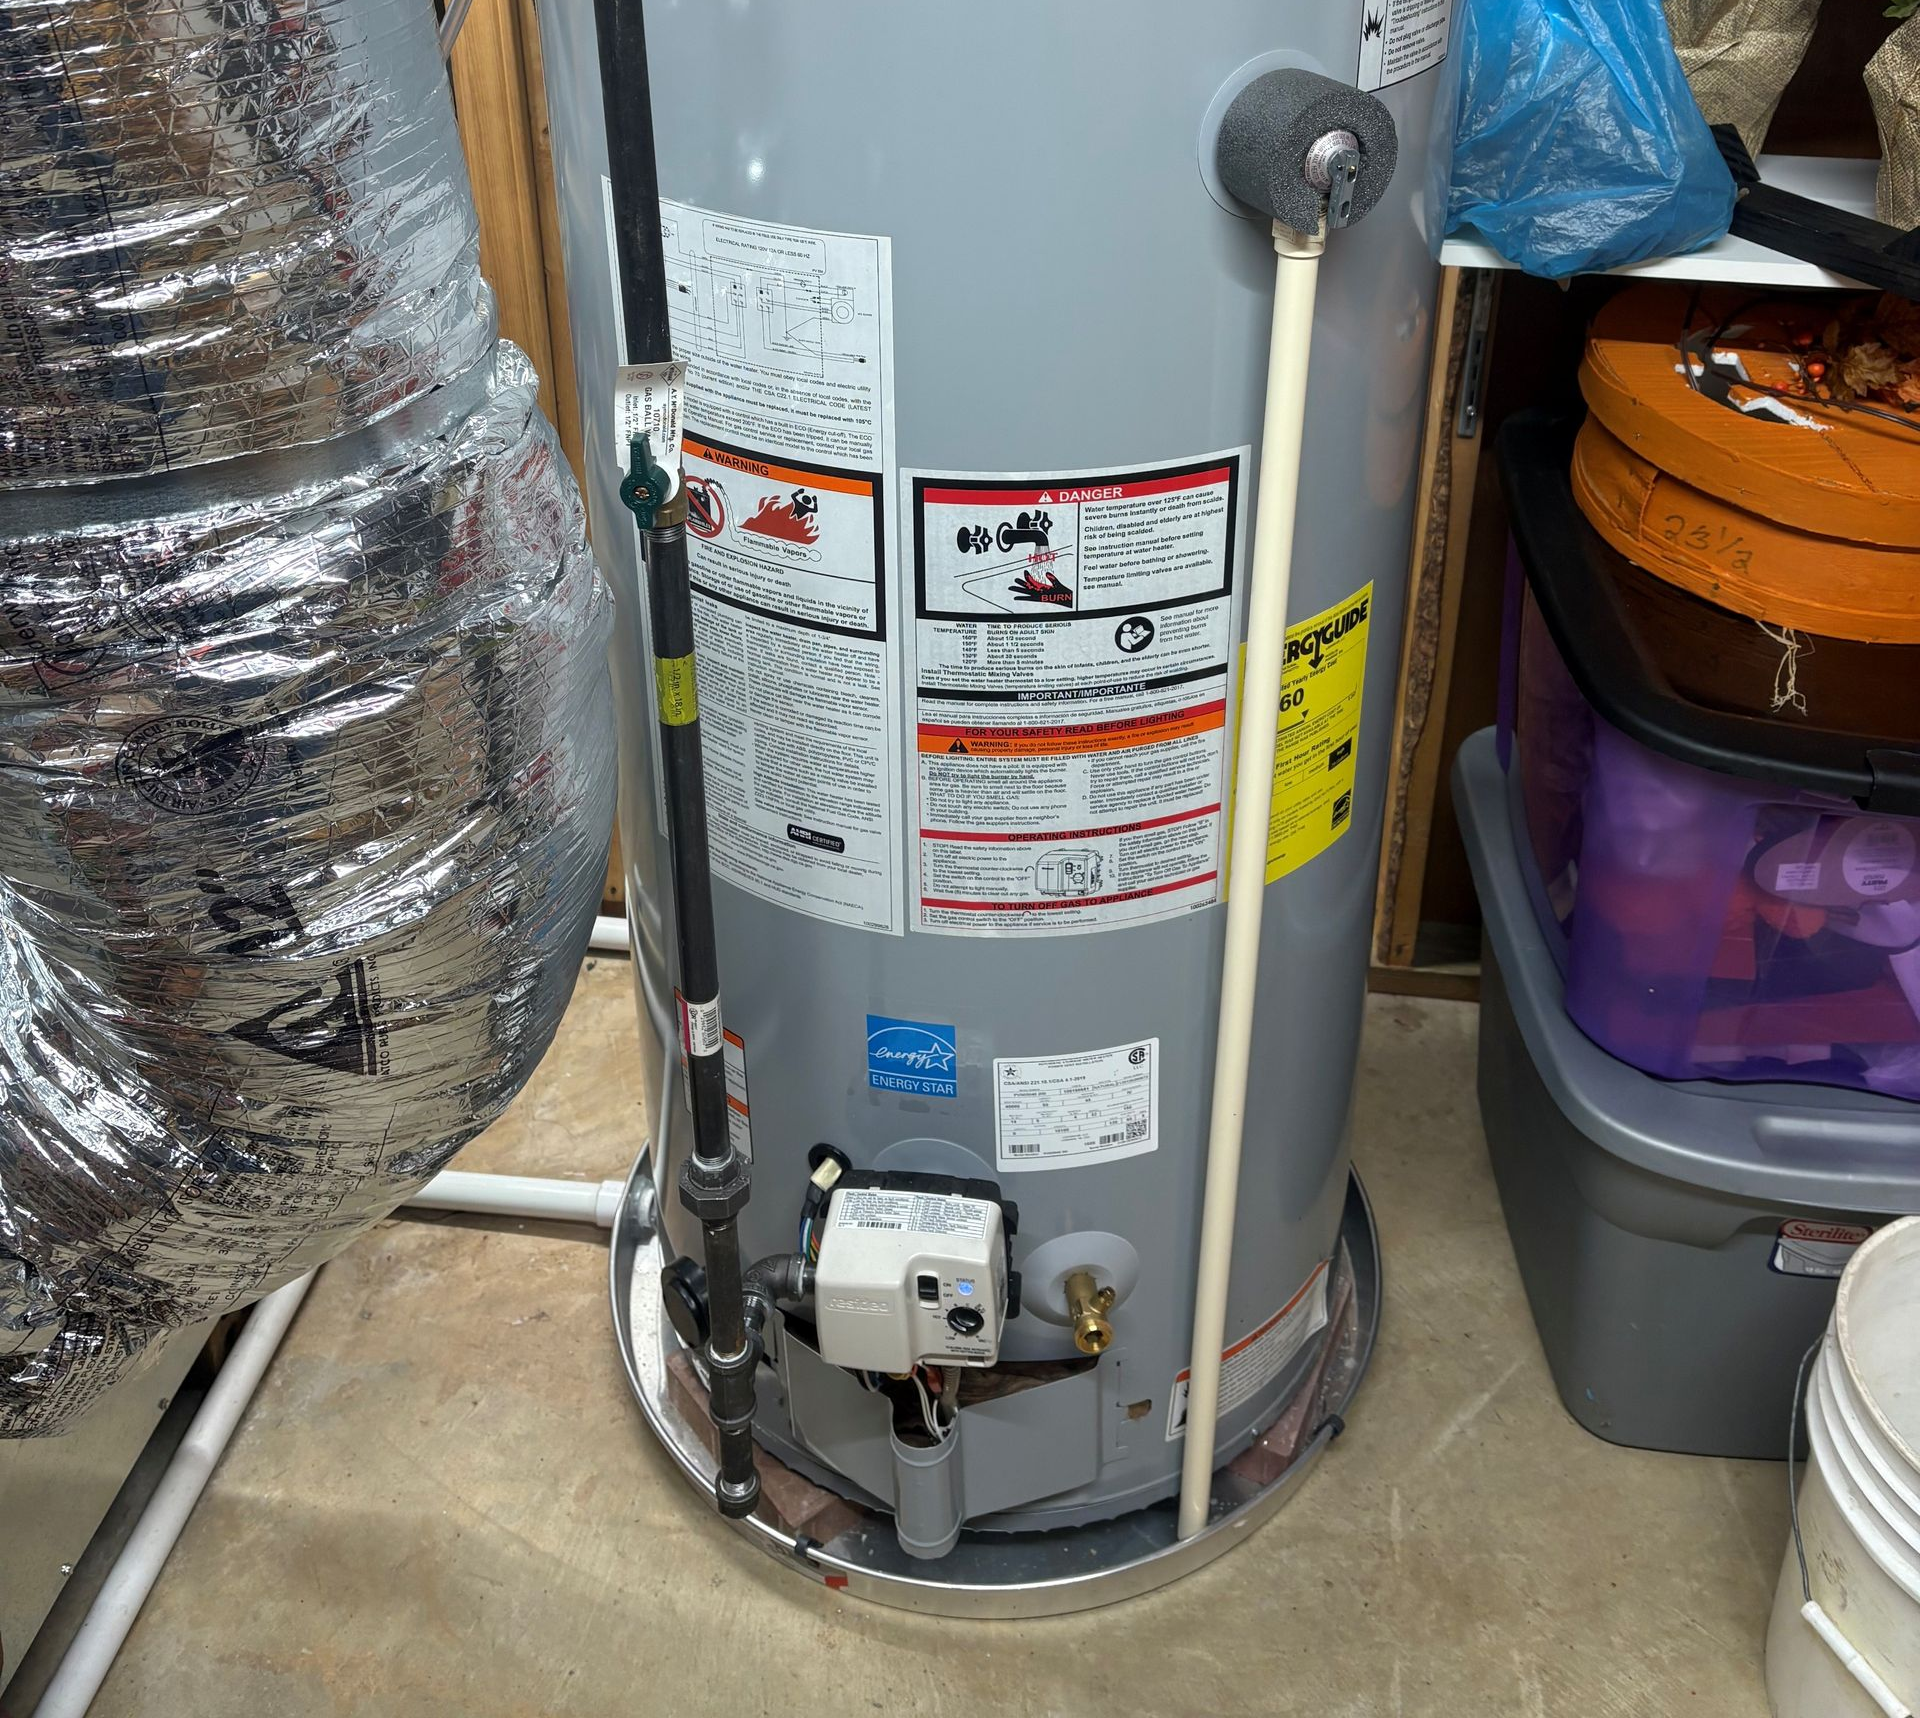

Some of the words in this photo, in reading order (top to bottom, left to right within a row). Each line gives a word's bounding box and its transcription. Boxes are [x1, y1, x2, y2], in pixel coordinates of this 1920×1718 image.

[644, 387, 652, 403] GAS
[644, 404, 652, 428] BALL
[714, 452, 769, 476] WARNING
[1059, 487, 1122, 503] DANGER
[1106, 502, 1146, 511] temperature
[1130, 507, 1158, 516] instantly
[1117, 520, 1144, 529] disabled
[1160, 515, 1181, 524] elderly
[1201, 507, 1224, 516] highest
[1099, 542, 1134, 550] instruction
[1136, 538, 1159, 546] manual
[1161, 535, 1181, 543] before
[1182, 531, 1203, 539] setting
[1127, 527, 1154, 536] scalded.
[743, 536, 780, 552] Flammable
[782, 546, 807, 558] Vapors
[1084, 551, 1124, 559] temperature
[701, 543, 712, 553] FIRE
[714, 549, 725, 557] AND
[726, 553, 758, 568] EXPLOSION
[759, 564, 784, 574] HAZARD
[697, 552, 706, 561] Can
[707, 558, 721, 567] result
[729, 566, 748, 576] serious
[750, 572, 766, 582] injury
[775, 579, 791, 587] death
[1083, 574, 1125, 582] Temperature
[1041, 592, 1072, 603] BURN
[1160, 619, 1191, 629] information
[1193, 614, 1208, 622] about
[1174, 610, 1194, 619] manual
[1160, 626, 1190, 637] preventing
[943, 669, 986, 677] Thermostatic
[1017, 682, 1147, 701] IMPORTANT/IMPORTANTE
[991, 728, 1019, 736] YOUR
[1022, 728, 1061, 736] SAFETY
[1065, 725, 1094, 735] READ
[1097, 720, 1137, 732] BEFORE
[1140, 711, 1185, 726] LIGHTING
[1275, 758, 1292, 770] First
[1293, 749, 1310, 762] Hour
[1311, 737, 1331, 752] Rating
[1008, 832, 1067, 842] OPERATING
[1069, 822, 1142, 840] INSTRUCTIONS
[1060, 900, 1081, 908] GAS
[1084, 898, 1098, 906] TO
[1100, 888, 1153, 904] APPLIANCE
[869, 1047, 937, 1069] energy
[872, 1074, 920, 1091] ENERGY
[922, 1082, 954, 1094] STAR
[1791, 1224, 1857, 1240] Sterilite
